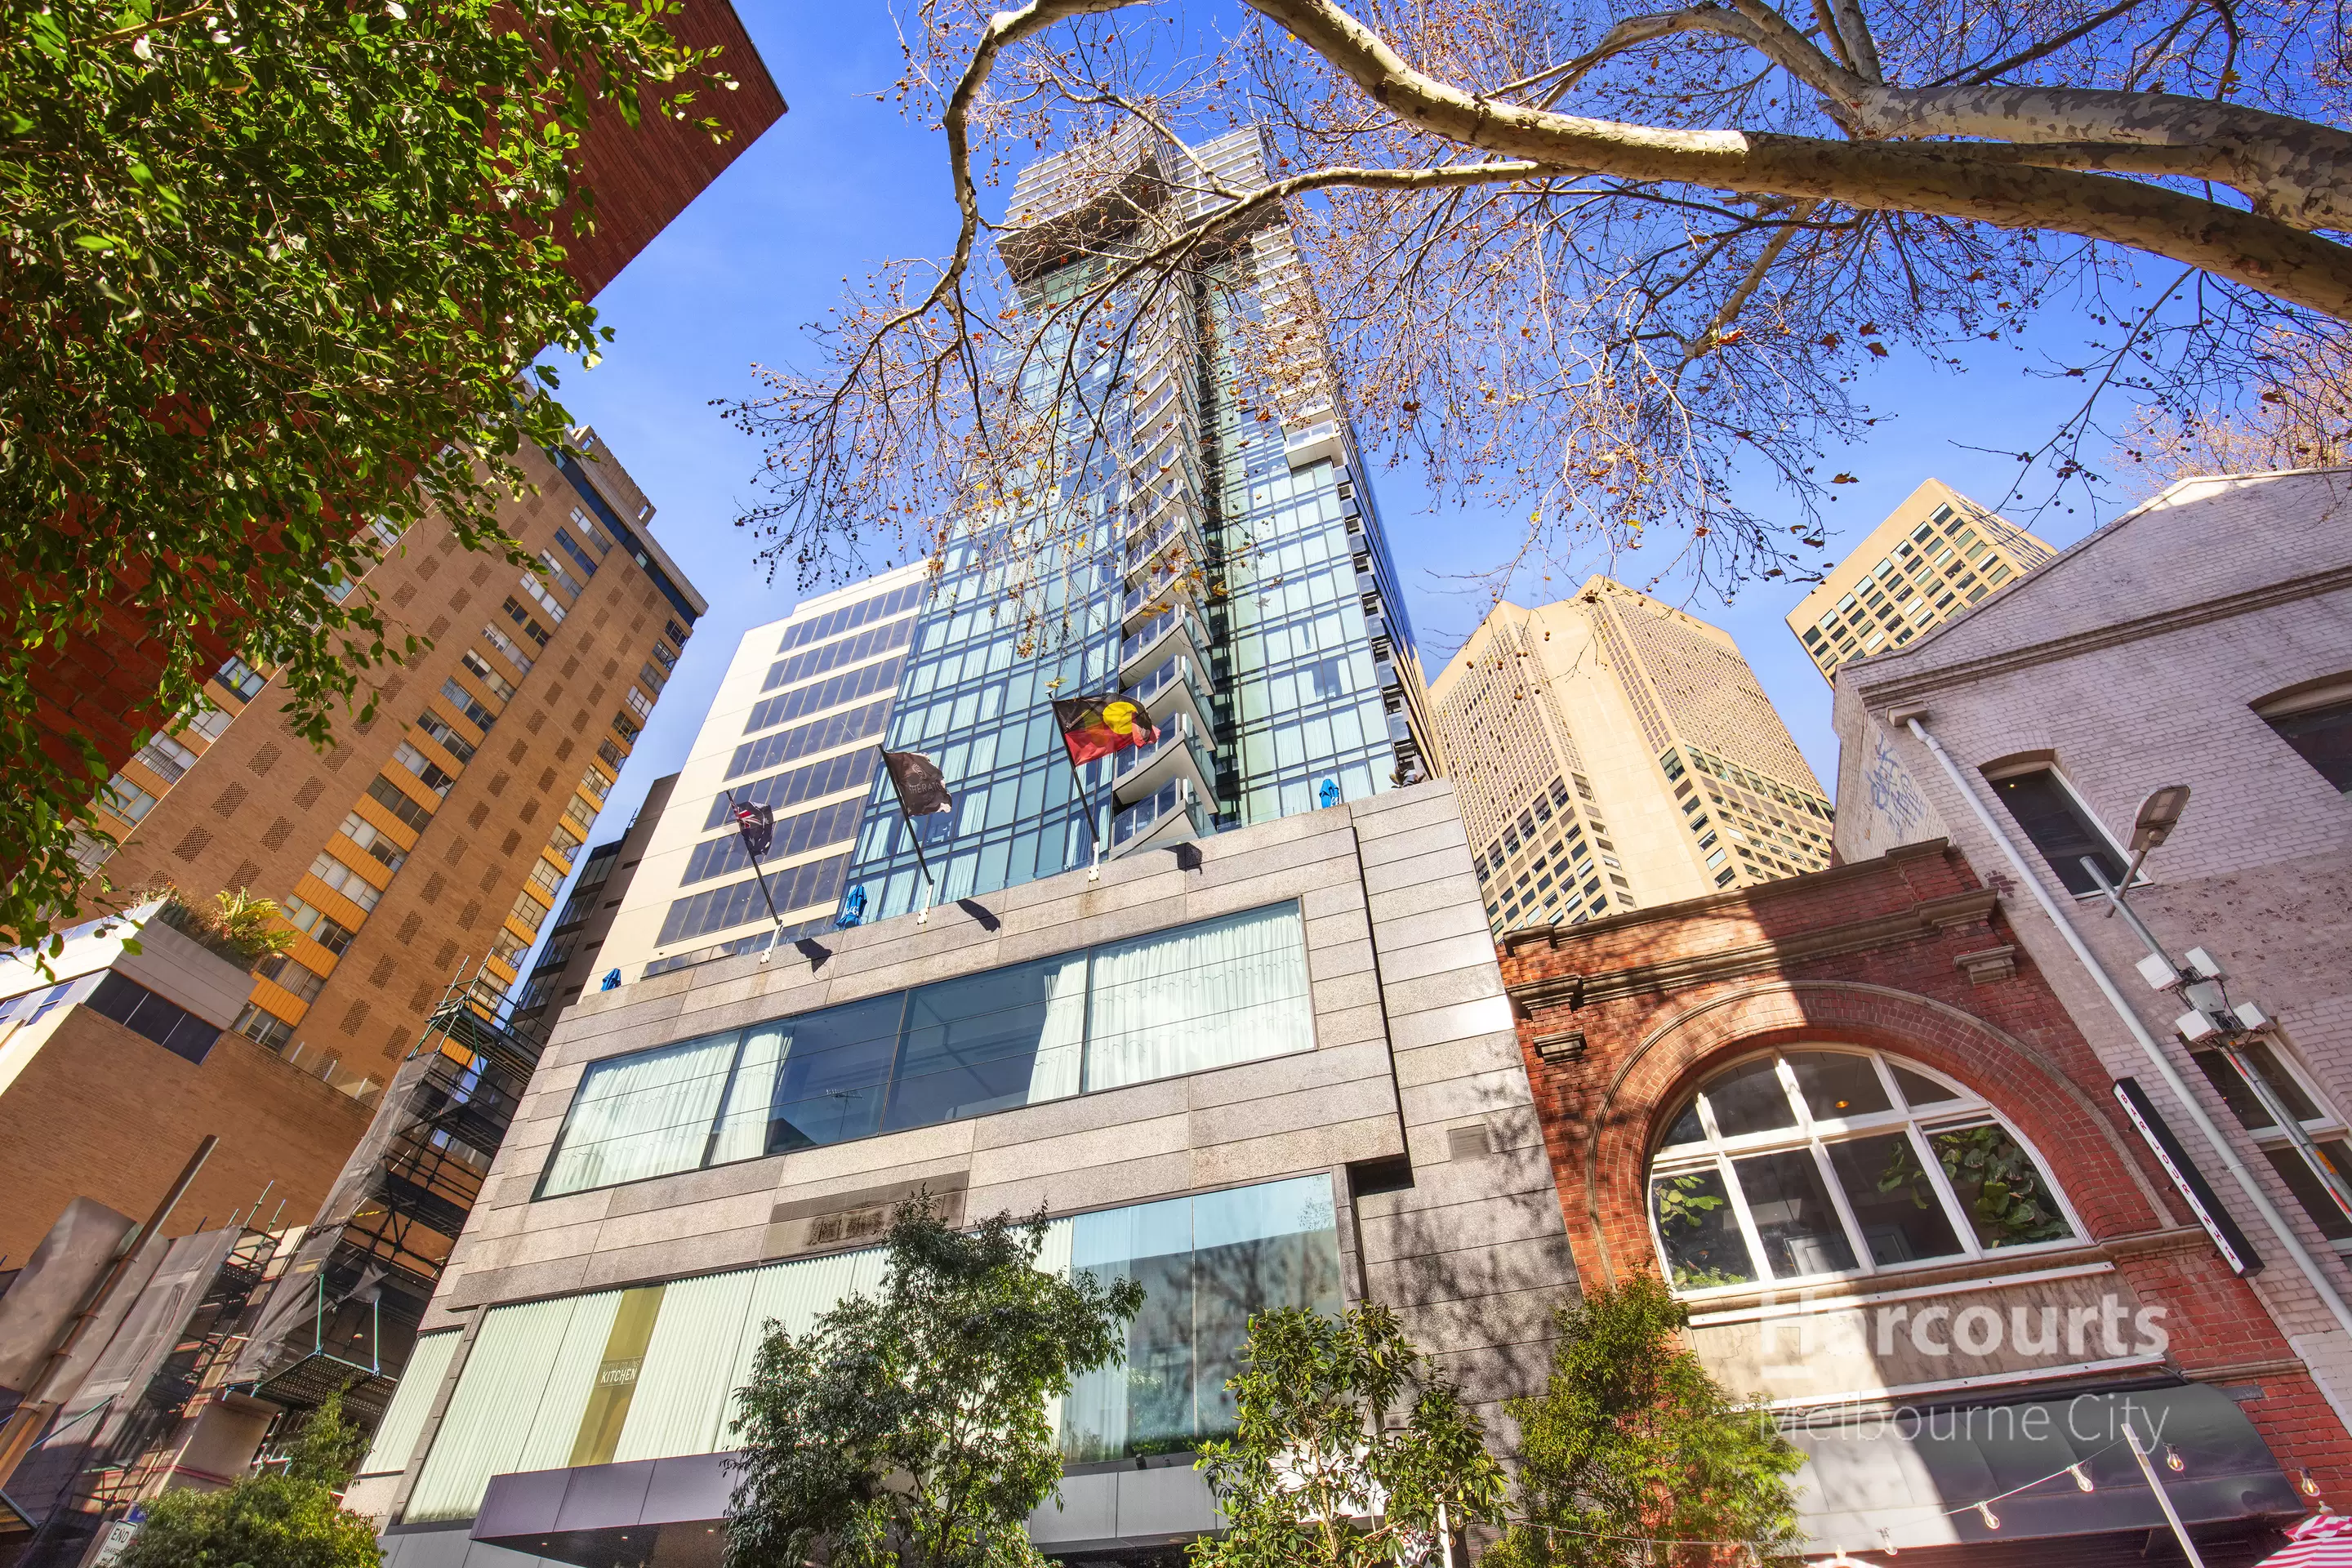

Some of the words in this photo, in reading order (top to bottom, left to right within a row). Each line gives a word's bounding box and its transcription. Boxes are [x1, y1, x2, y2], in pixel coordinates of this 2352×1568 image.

[908, 782, 942, 795] SHERATO
[2121, 1094, 2147, 1131] BAR
[600, 1367, 638, 1385] KITCHEN
[110, 1528, 130, 1544] END
